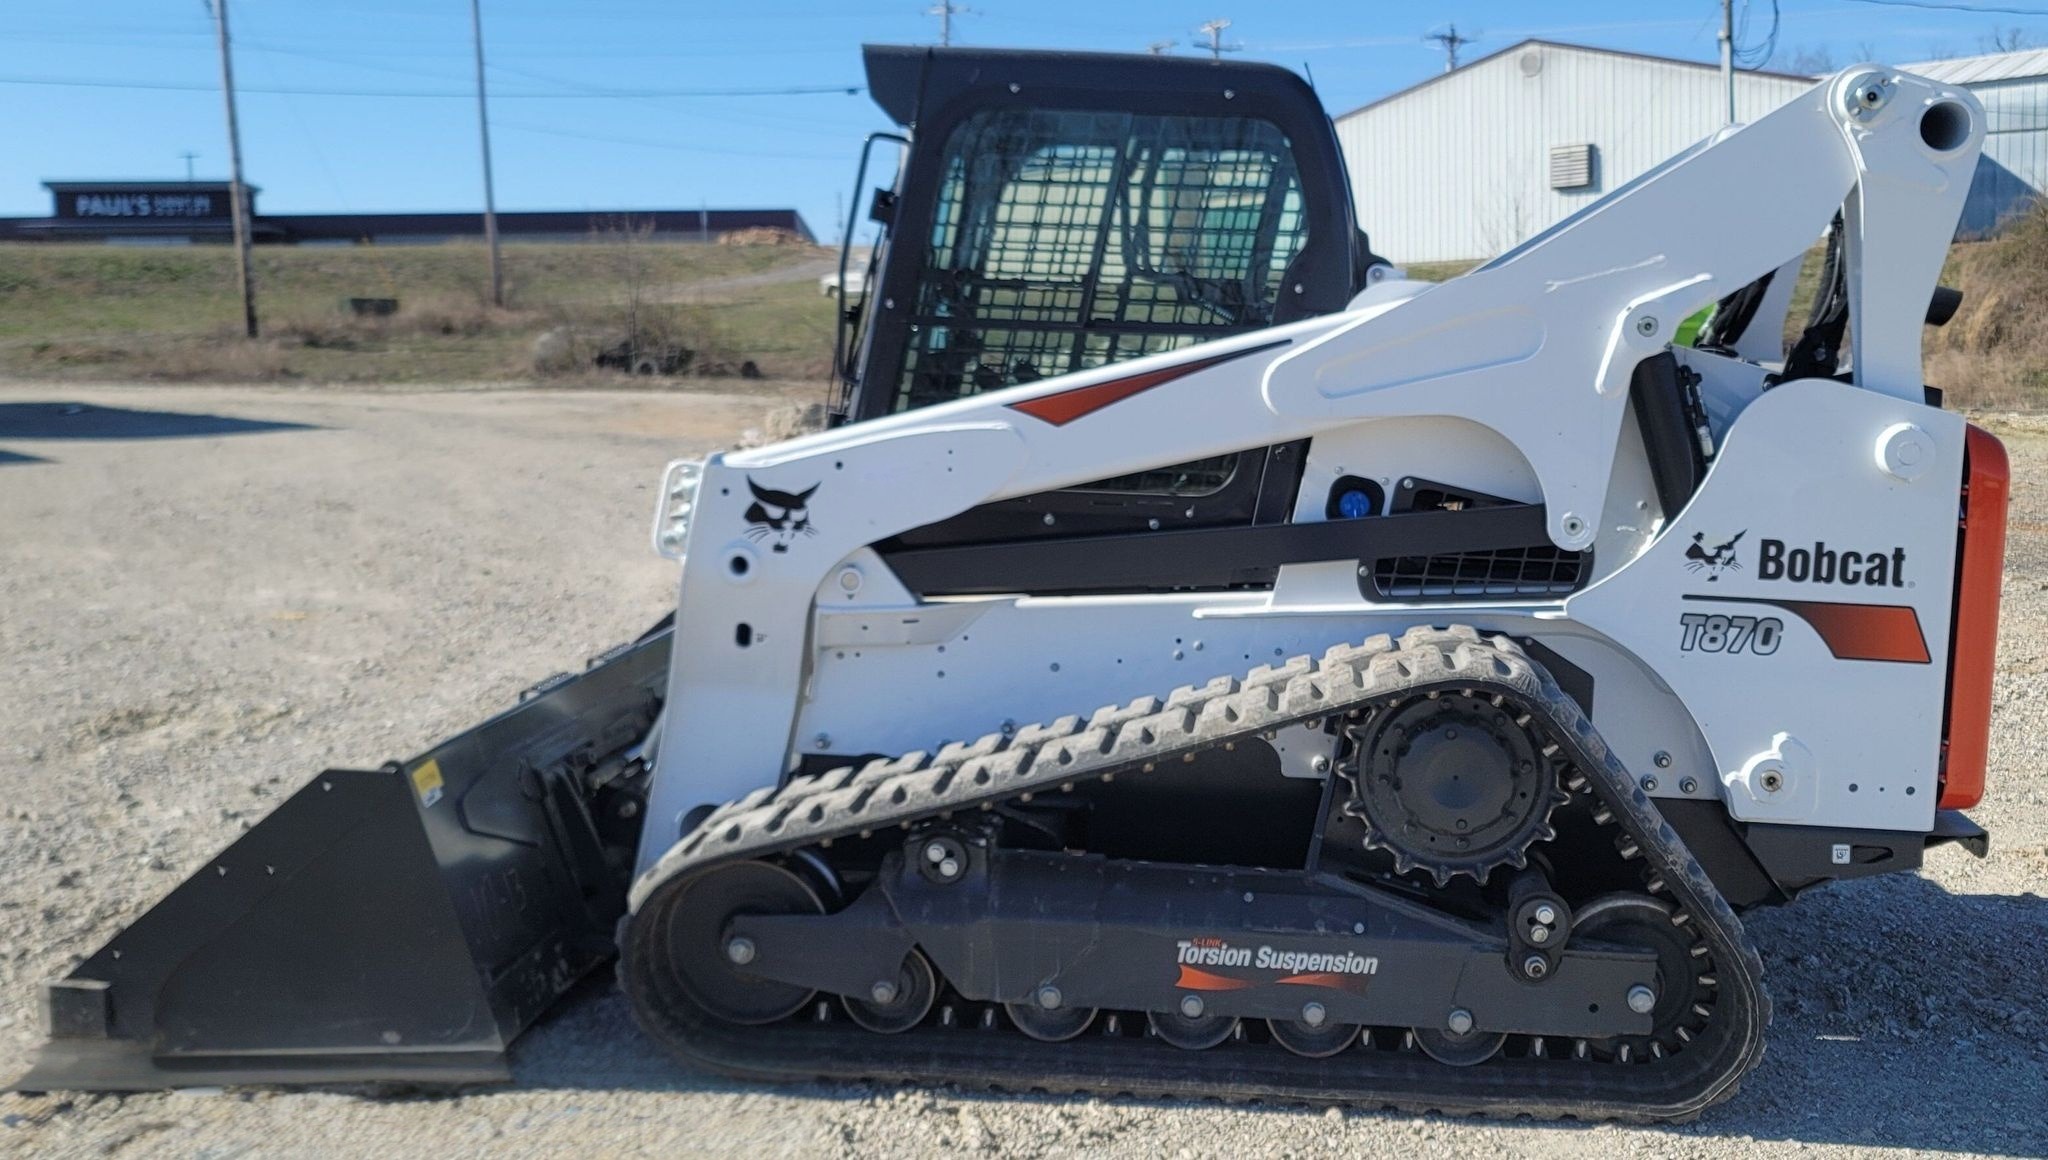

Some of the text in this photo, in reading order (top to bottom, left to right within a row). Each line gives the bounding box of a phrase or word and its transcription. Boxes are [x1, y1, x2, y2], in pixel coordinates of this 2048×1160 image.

[75, 194, 150, 216] PAUL'S
[1758, 538, 1906, 588] Bobcat
[1680, 613, 1784, 656] T870
[1177, 941, 1379, 975] Torsion Suspension
